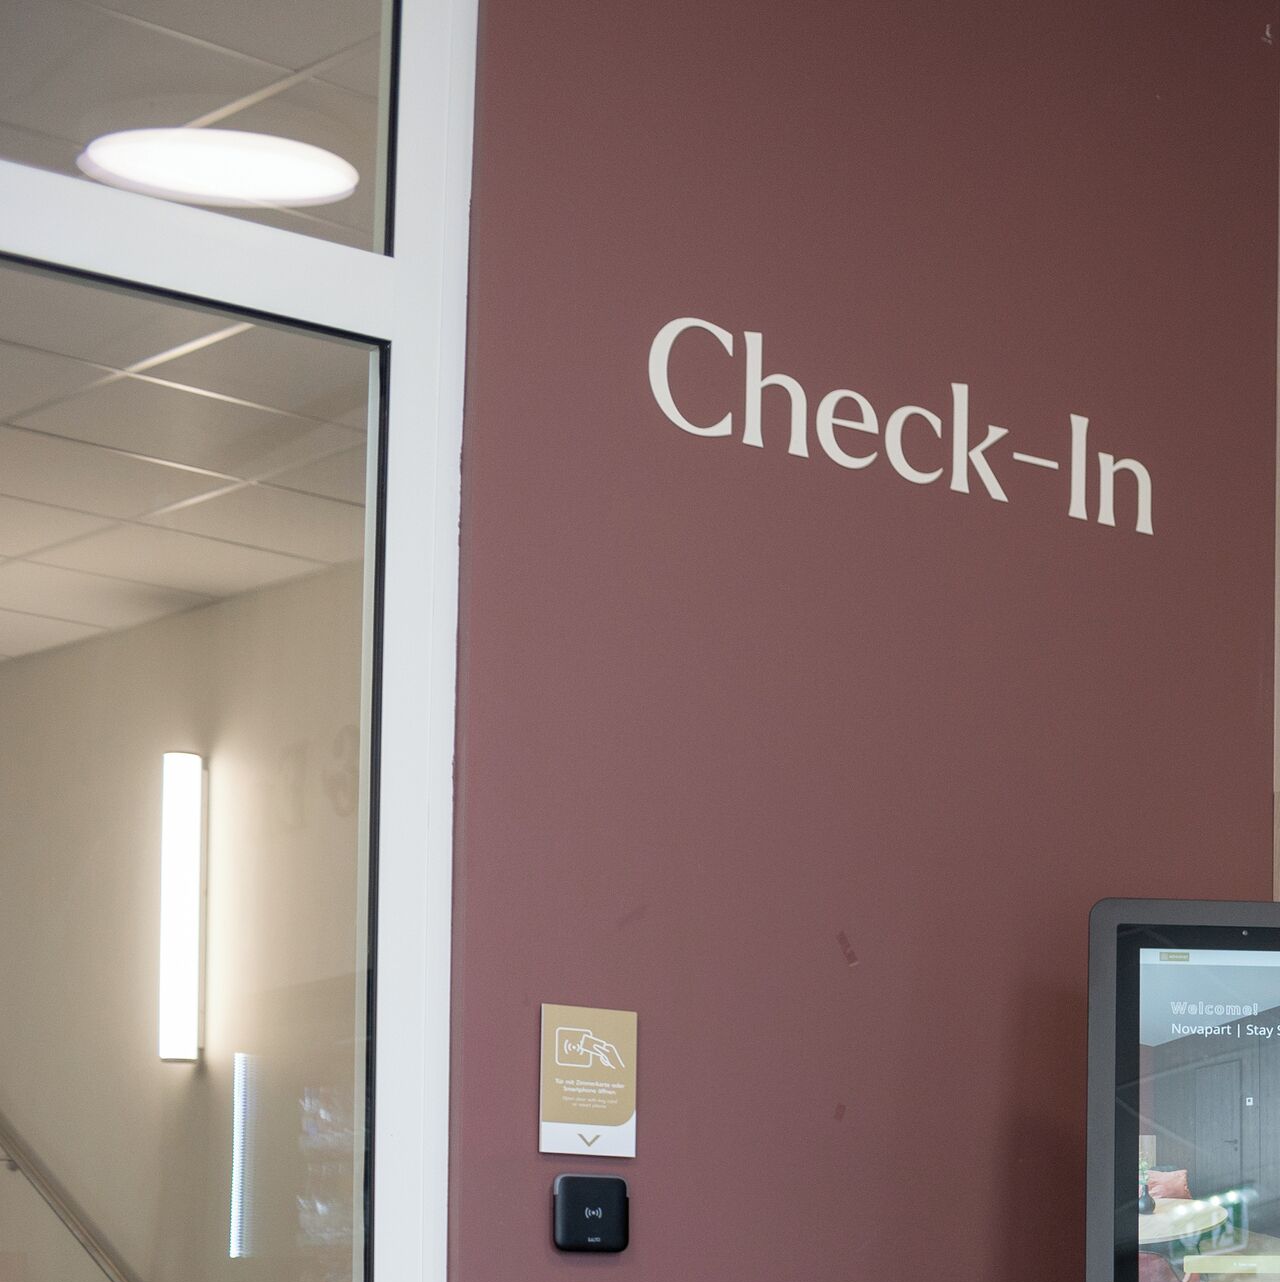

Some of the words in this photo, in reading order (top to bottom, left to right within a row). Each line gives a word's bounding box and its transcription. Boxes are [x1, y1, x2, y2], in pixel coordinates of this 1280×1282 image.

[648, 316, 1155, 535] Check-In
[1170, 1001, 1259, 1016] Welcome!
[1171, 1024, 1232, 1040] Novapart
[1246, 1024, 1275, 1040] Stay
